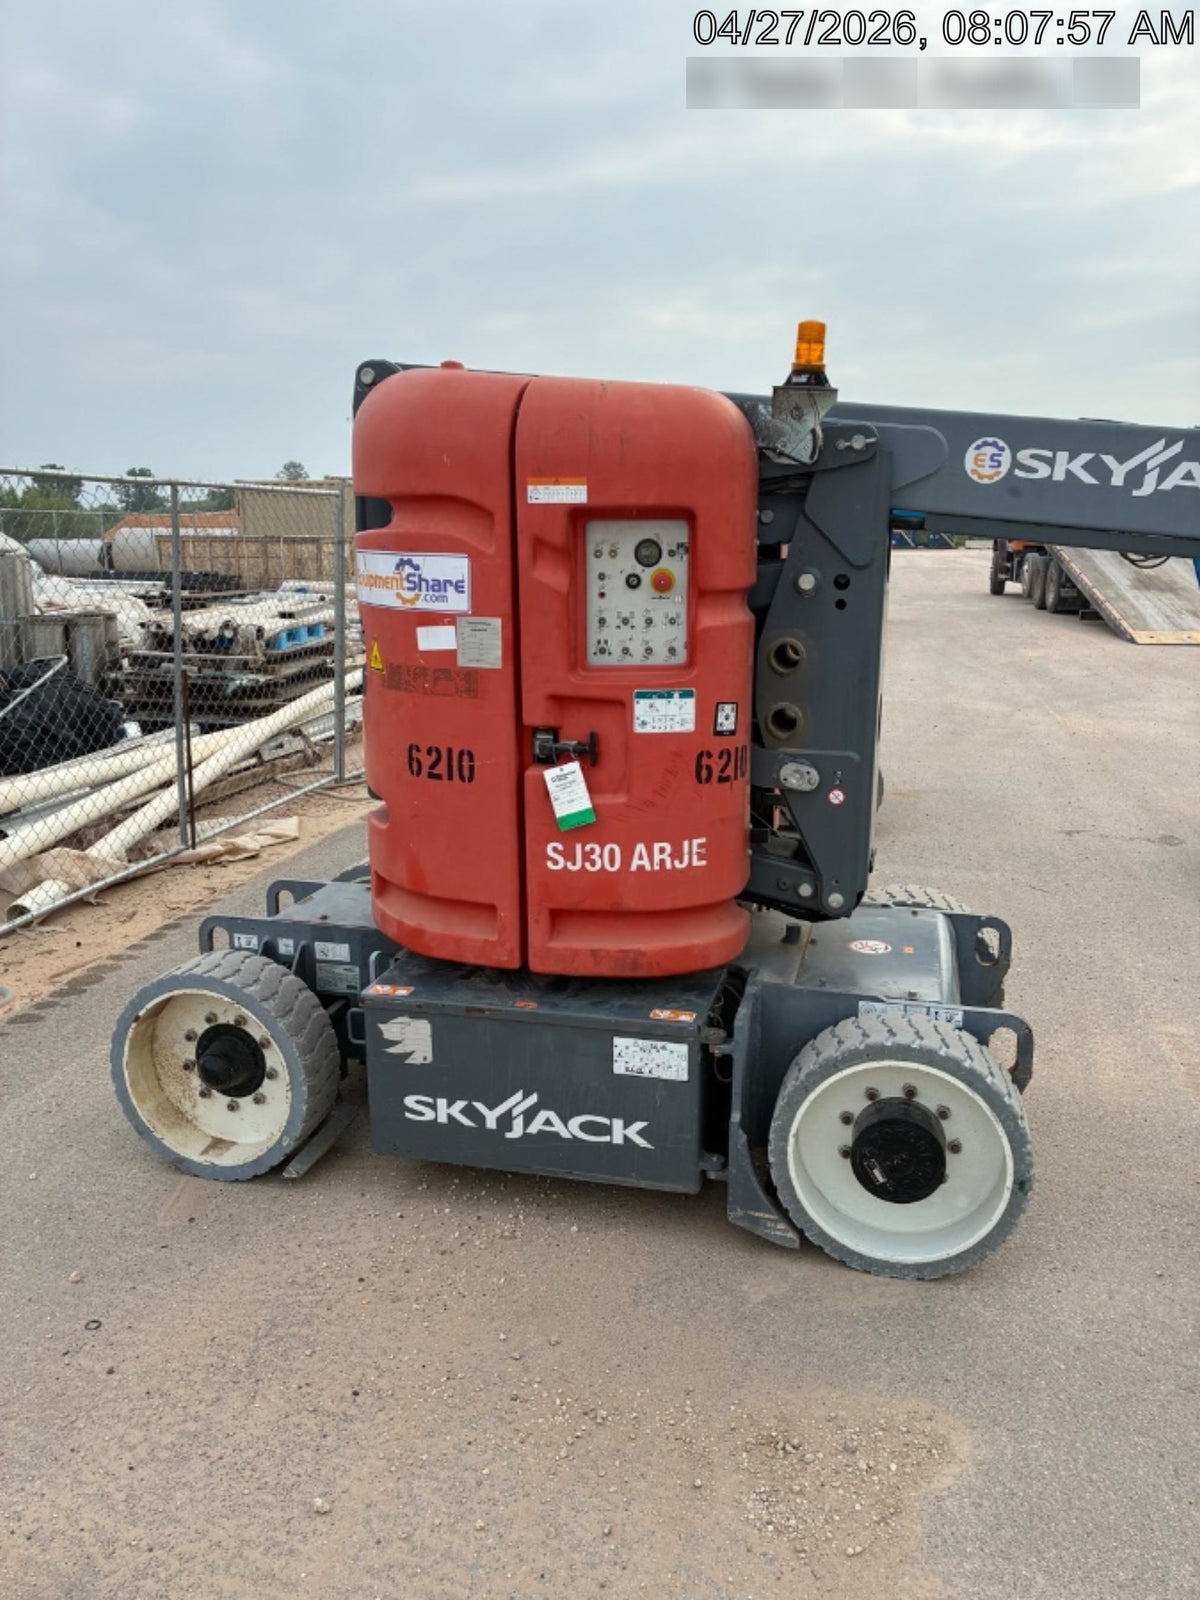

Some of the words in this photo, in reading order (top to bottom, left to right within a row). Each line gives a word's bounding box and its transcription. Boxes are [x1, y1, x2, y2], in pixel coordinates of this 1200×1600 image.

[973, 451, 1003, 469] ES
[421, 593, 449, 604] .com
[408, 743, 476, 783] 6210
[694, 744, 748, 784] 6210
[546, 841, 622, 872] SJ30
[629, 837, 708, 872] ARJE
[403, 1089, 655, 1149] SKYJACK
